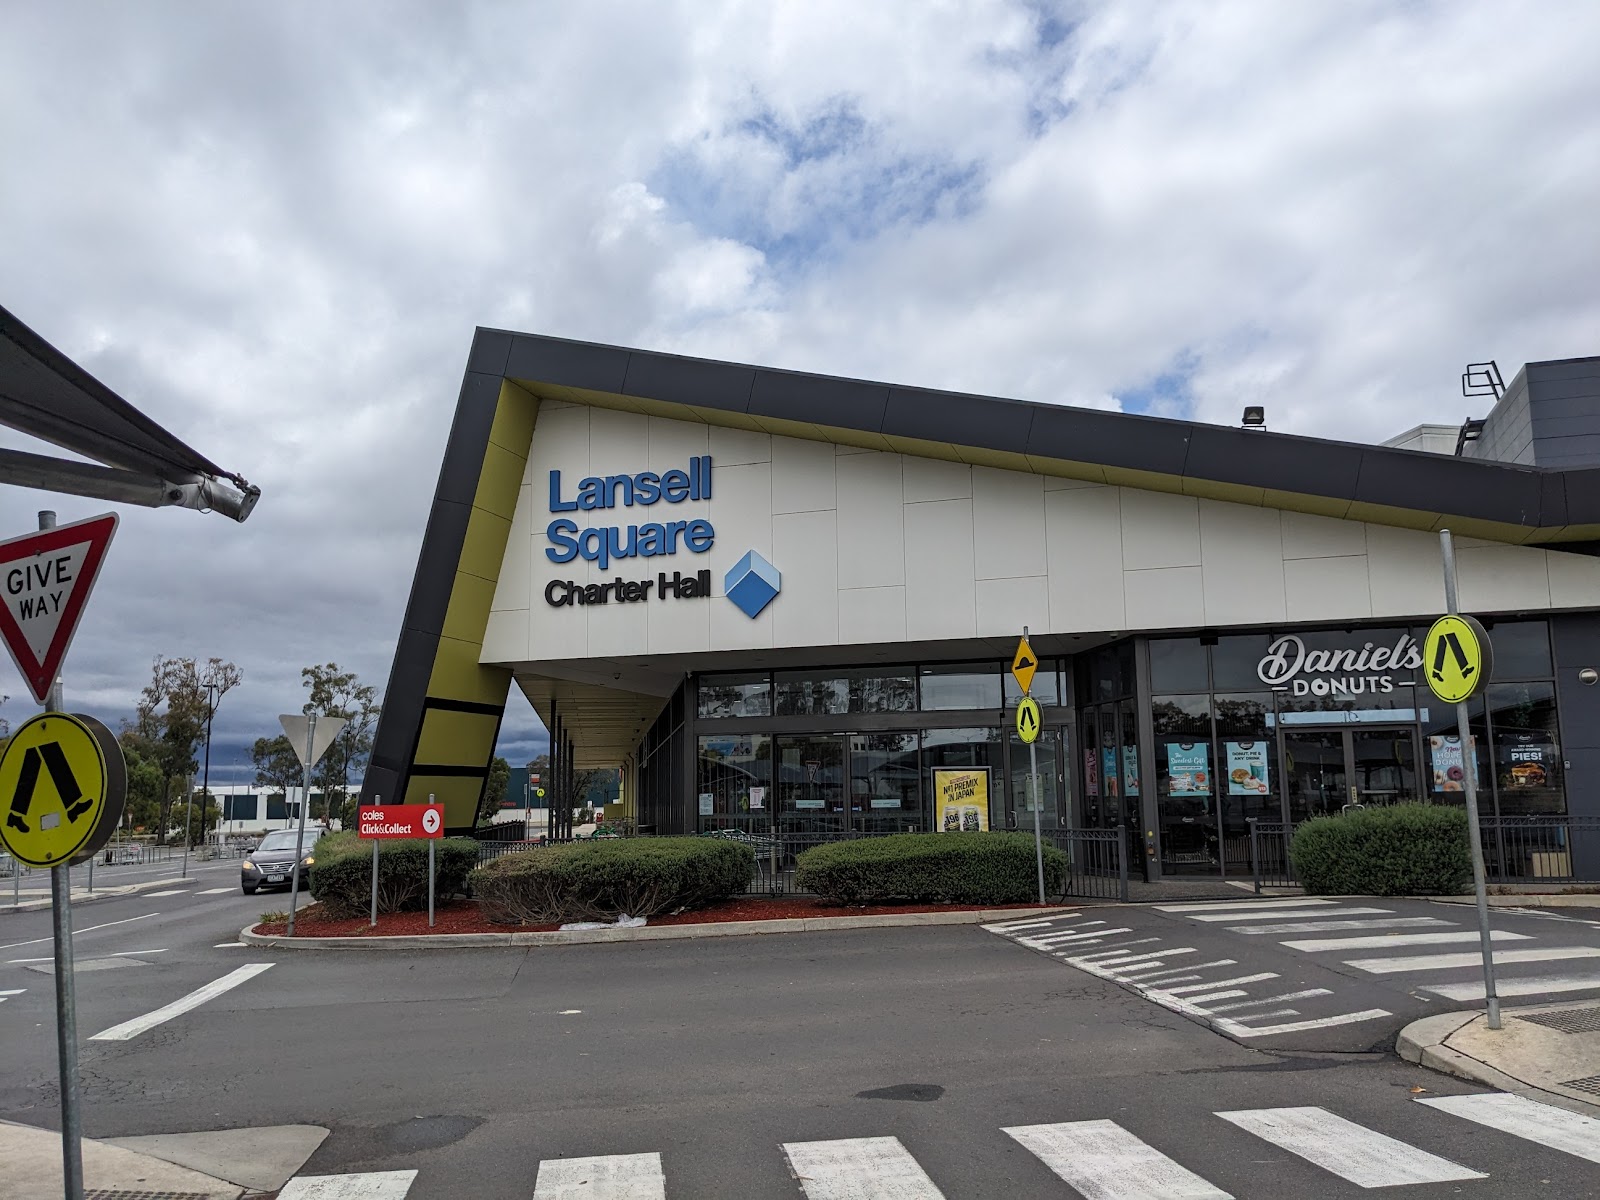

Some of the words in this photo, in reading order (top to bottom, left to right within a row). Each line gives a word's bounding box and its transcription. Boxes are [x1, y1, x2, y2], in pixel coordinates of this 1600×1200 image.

[549, 455, 712, 513] Lansell
[545, 518, 715, 570] Square
[7, 555, 72, 595] GIVE
[544, 577, 653, 607] Charter
[658, 569, 711, 600] Hall
[19, 590, 63, 621] WAY
[1257, 633, 1424, 685] Daniel's
[1293, 675, 1393, 696] DONUTS
[1511, 752, 1542, 761] PIES!
[948, 793, 954, 802] IN
[955, 788, 974, 800] JAPAN
[955, 778, 978, 791] PREMIX
[361, 809, 385, 821] coles
[361, 823, 412, 834] Click&Collect
